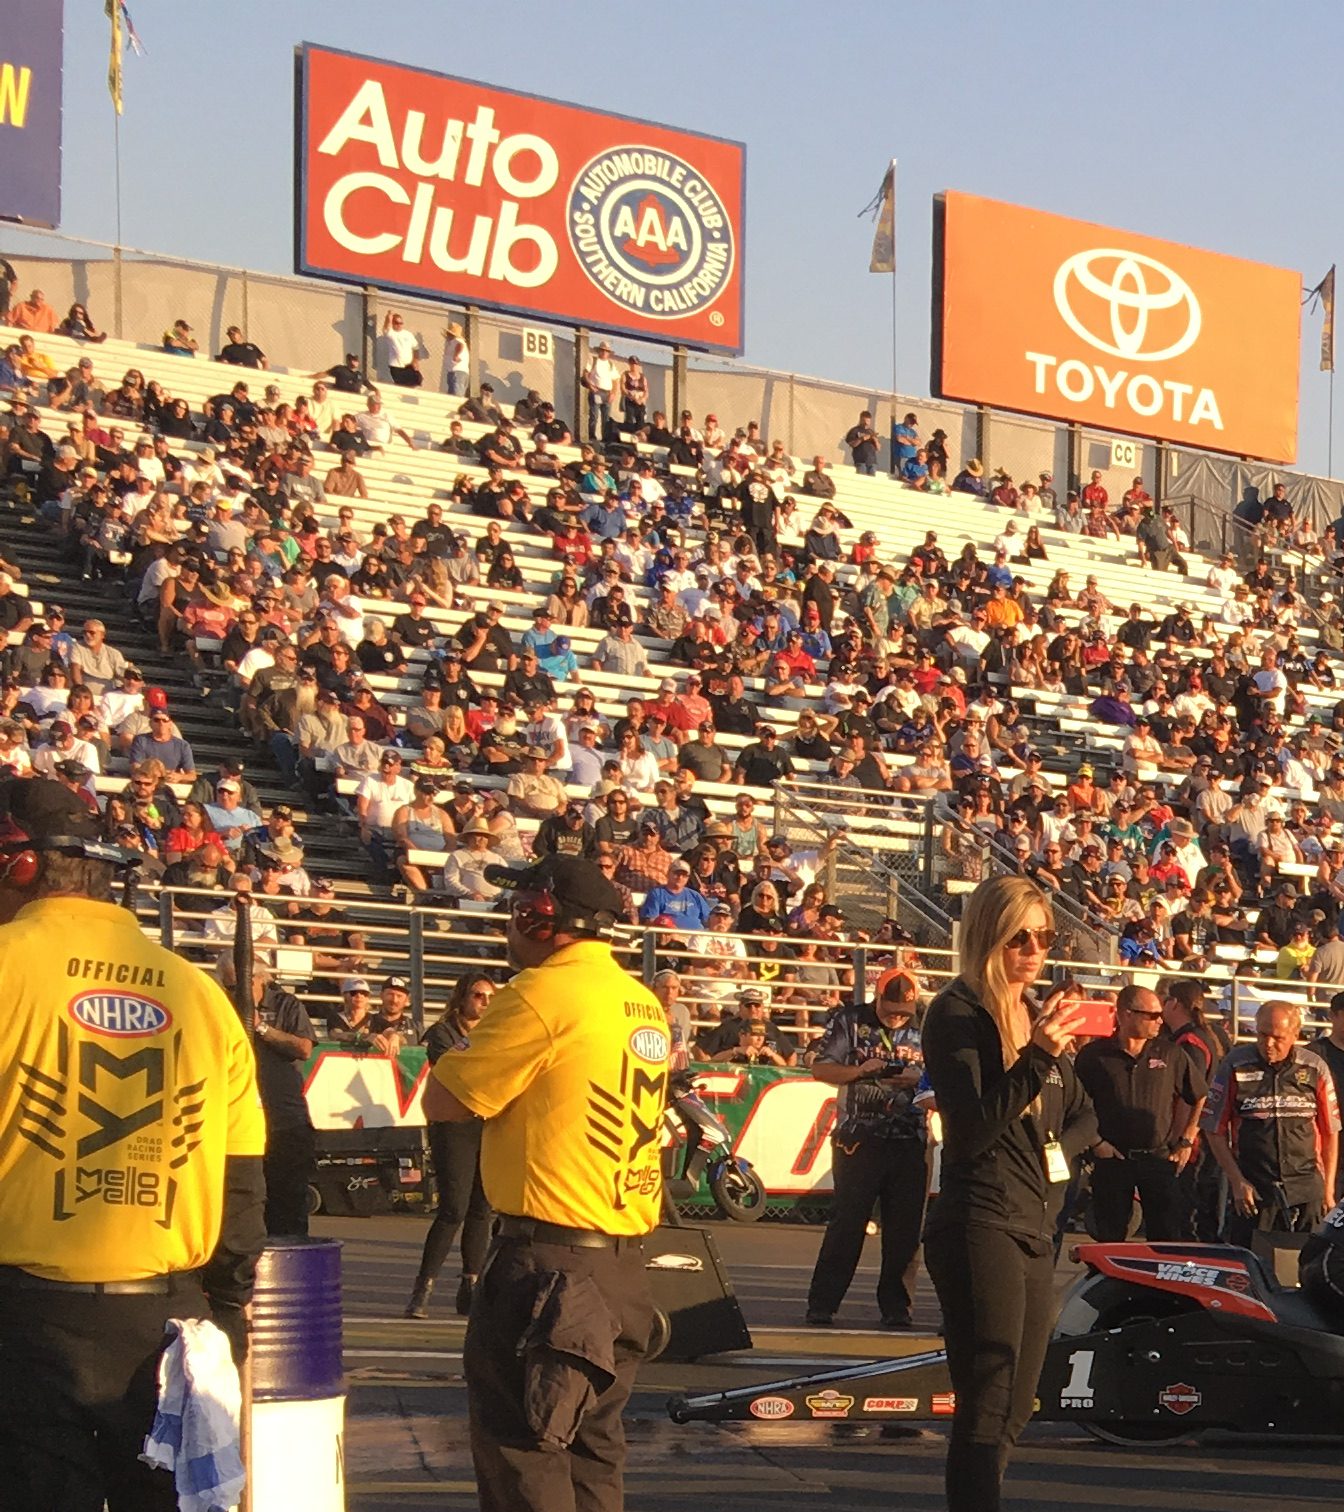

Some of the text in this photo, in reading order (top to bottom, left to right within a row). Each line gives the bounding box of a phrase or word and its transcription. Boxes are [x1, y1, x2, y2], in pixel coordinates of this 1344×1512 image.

[317, 79, 559, 199] Auto
[579, 153, 723, 229] AUTOMOBILE CLUB
[323, 172, 558, 288] Club
[614, 205, 688, 251] AAA
[573, 211, 728, 312] SOUTHERN CALIFORNIA
[526, 332, 549, 355] BB
[1025, 351, 1224, 430] TOYOTA
[1114, 442, 1134, 463] CC
[66, 957, 166, 988] OFFICIAL
[81, 997, 159, 1031] NHRA
[896, 1045, 924, 1063] Fis
[126, 1144, 163, 1154] RACING
[136, 1135, 163, 1145] DRAG
[126, 1153, 162, 1163] SERIES
[1060, 1350, 1095, 1398] 1
[757, 1402, 788, 1415] NHRA
[1060, 1398, 1094, 1409] PRO
